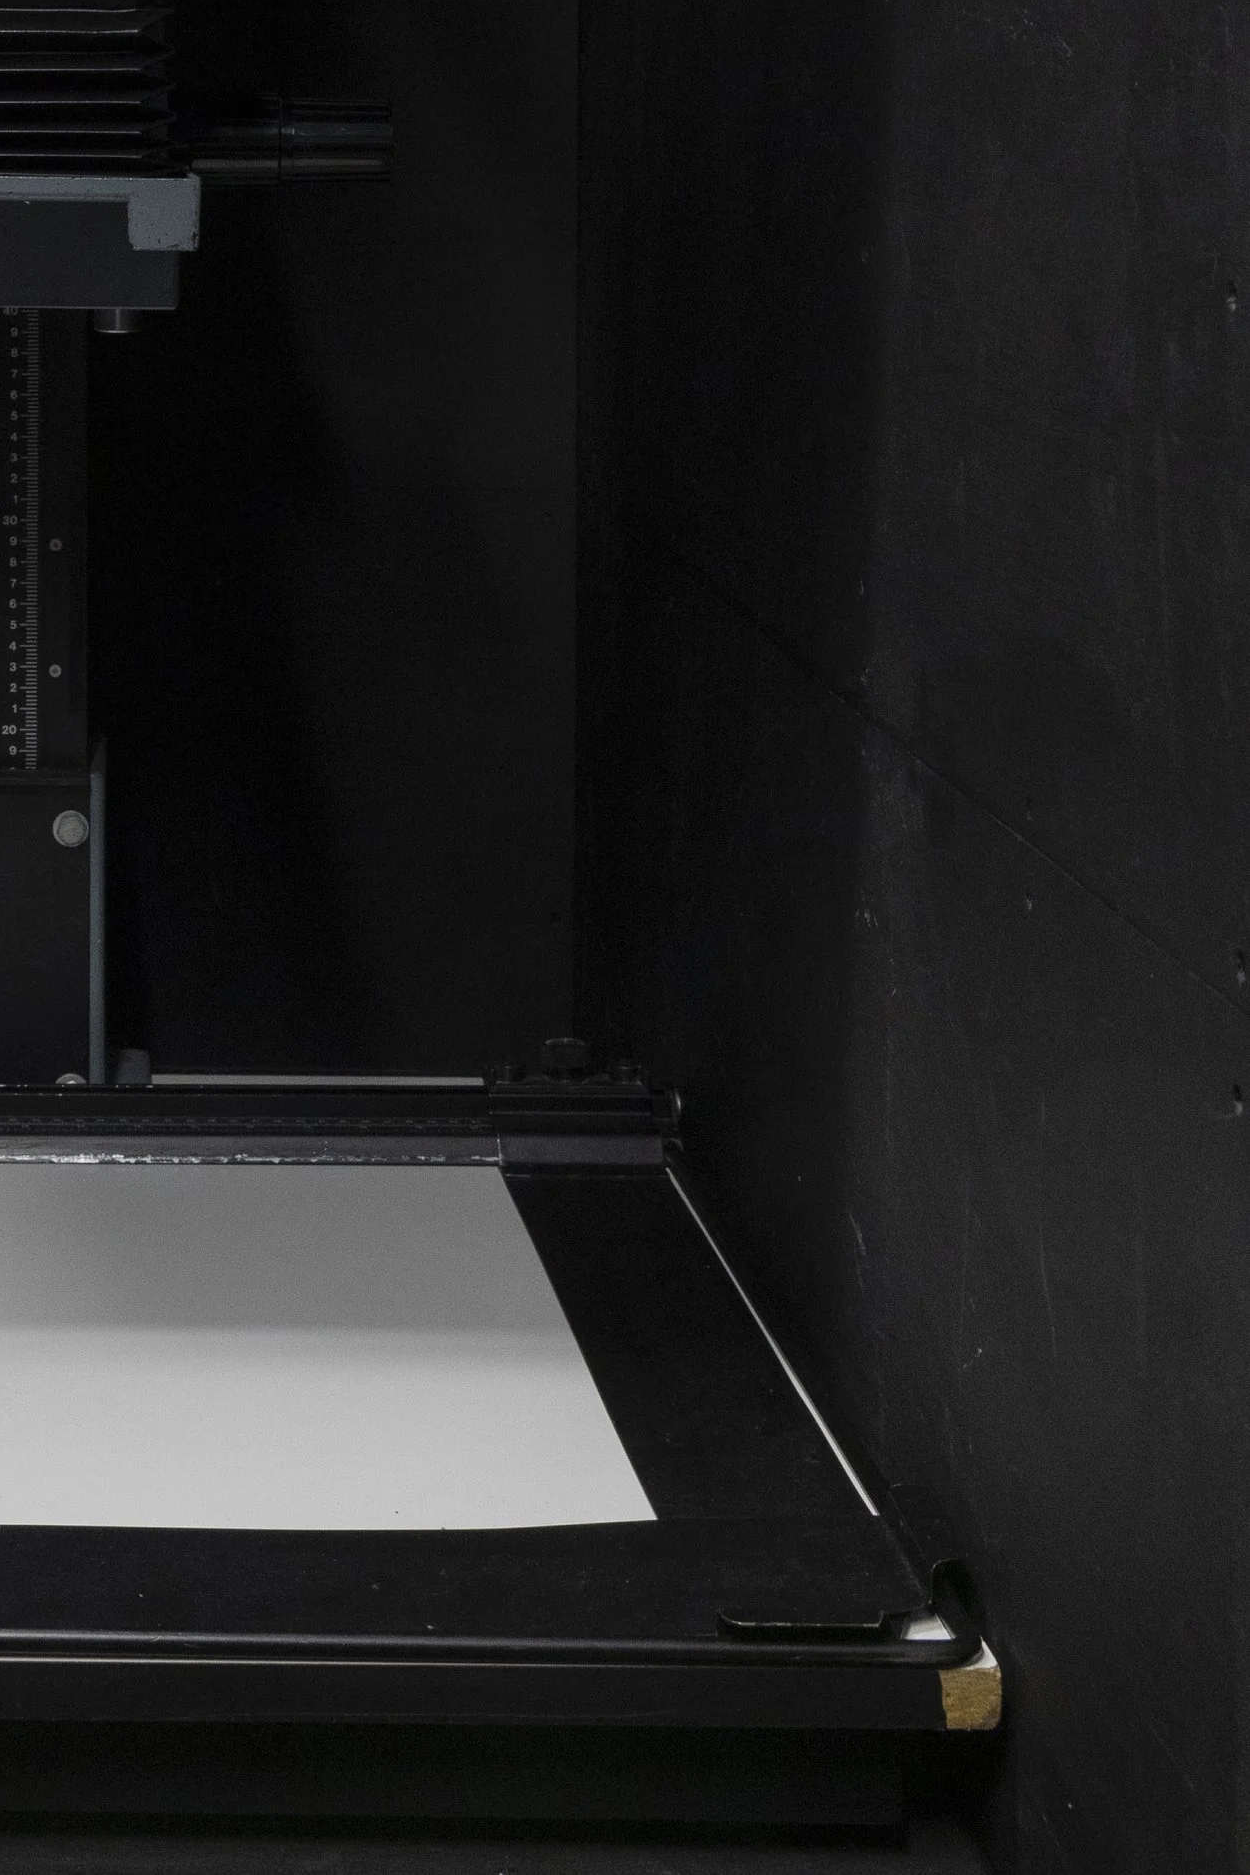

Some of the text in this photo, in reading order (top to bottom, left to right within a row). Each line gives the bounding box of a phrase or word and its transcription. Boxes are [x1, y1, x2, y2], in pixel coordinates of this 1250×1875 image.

[10, 327, 18, 337] 9
[11, 348, 18, 357] 8
[11, 369, 18, 378] 7
[10, 390, 18, 400] 6
[11, 411, 18, 420] 5
[10, 432, 18, 441] 4
[10, 453, 18, 462] 3
[11, 473, 17, 483] 2
[13, 495, 18, 503] 1
[2, 515, 18, 525] 30
[10, 536, 17, 546] 9
[10, 557, 17, 567] 8
[10, 578, 17, 588] 7
[9, 599, 17, 608] 6
[10, 620, 17, 629] 5
[9, 641, 16, 650] 4
[10, 662, 17, 672] 3
[10, 683, 17, 692] 2
[12, 704, 17, 713] 1
[2, 725, 17, 735] 20
[9, 745, 17, 755] 9
